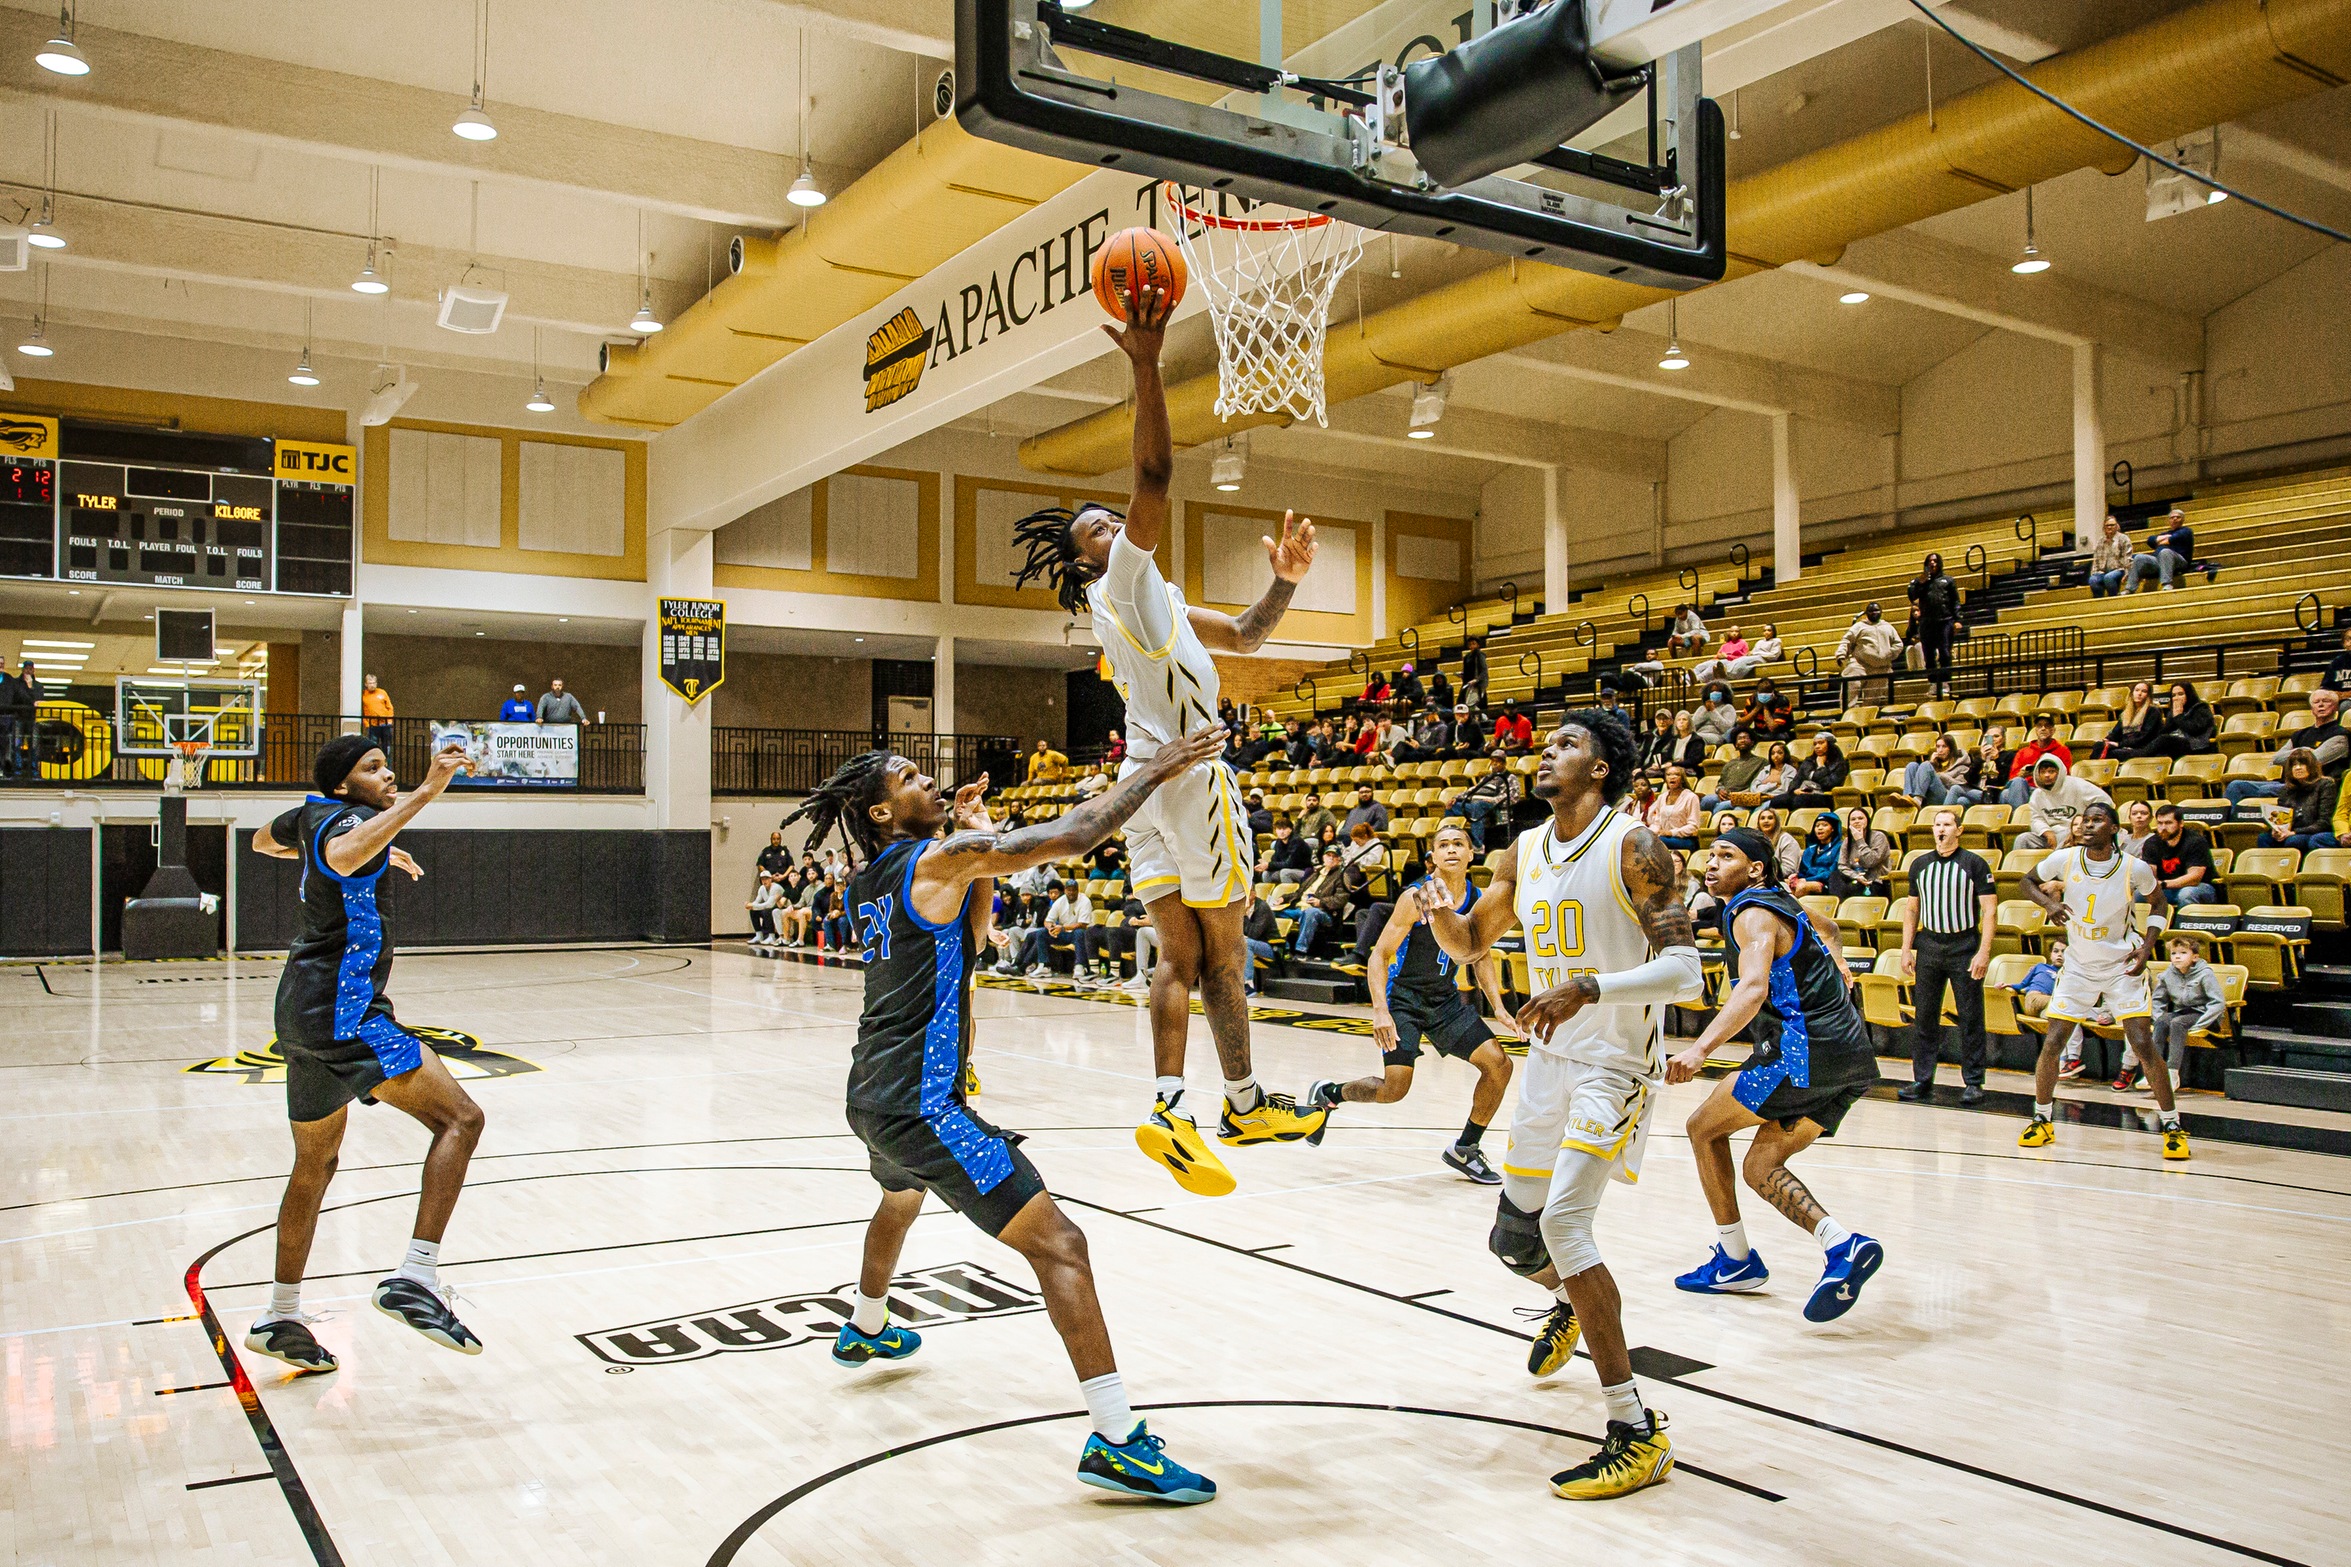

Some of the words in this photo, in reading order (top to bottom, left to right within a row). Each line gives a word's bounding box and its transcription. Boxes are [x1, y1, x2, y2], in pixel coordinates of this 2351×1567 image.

[929, 208, 1110, 370] APACHE
[4, 456, 17, 464] FLS
[33, 459, 47, 468] PTS
[302, 451, 349, 474] TJC
[12, 468, 23, 483] 2
[34, 470, 51, 485] 12
[282, 480, 299, 488] PLYR
[309, 482, 321, 491] FLS
[334, 484, 347, 492] PTS
[77, 494, 117, 510] TYLER
[153, 507, 184, 517] PERIOD
[214, 504, 262, 521] KILGORE
[68, 536, 97, 547] FOULS
[107, 539, 131, 549] T.O.L.
[139, 542, 171, 551] PLAYER
[176, 544, 198, 554] FOUL
[205, 546, 229, 556] T.O.L.
[236, 548, 263, 558] FOULS
[68, 570, 97, 580] SCORE
[154, 575, 184, 585] MATCH
[235, 580, 262, 590] SCORE
[664, 600, 688, 609] TYLER
[691, 602, 720, 612] JUNIOR
[670, 608, 713, 618] COLLEGE
[671, 624, 712, 632] APPEARANCES
[680, 617, 721, 630] TOURNAMENT
[496, 736, 574, 750] OPPORTUNITIES
[496, 750, 517, 758] START
[518, 750, 535, 759] HERE
[2082, 893, 2097, 925] 1
[1531, 898, 1586, 958] 20
[2070, 920, 2109, 940] TYLER
[2179, 922, 2231, 931] RESERVED
[2247, 923, 2302, 932] RESERVED
[1570, 1117, 1606, 1138] YLER
